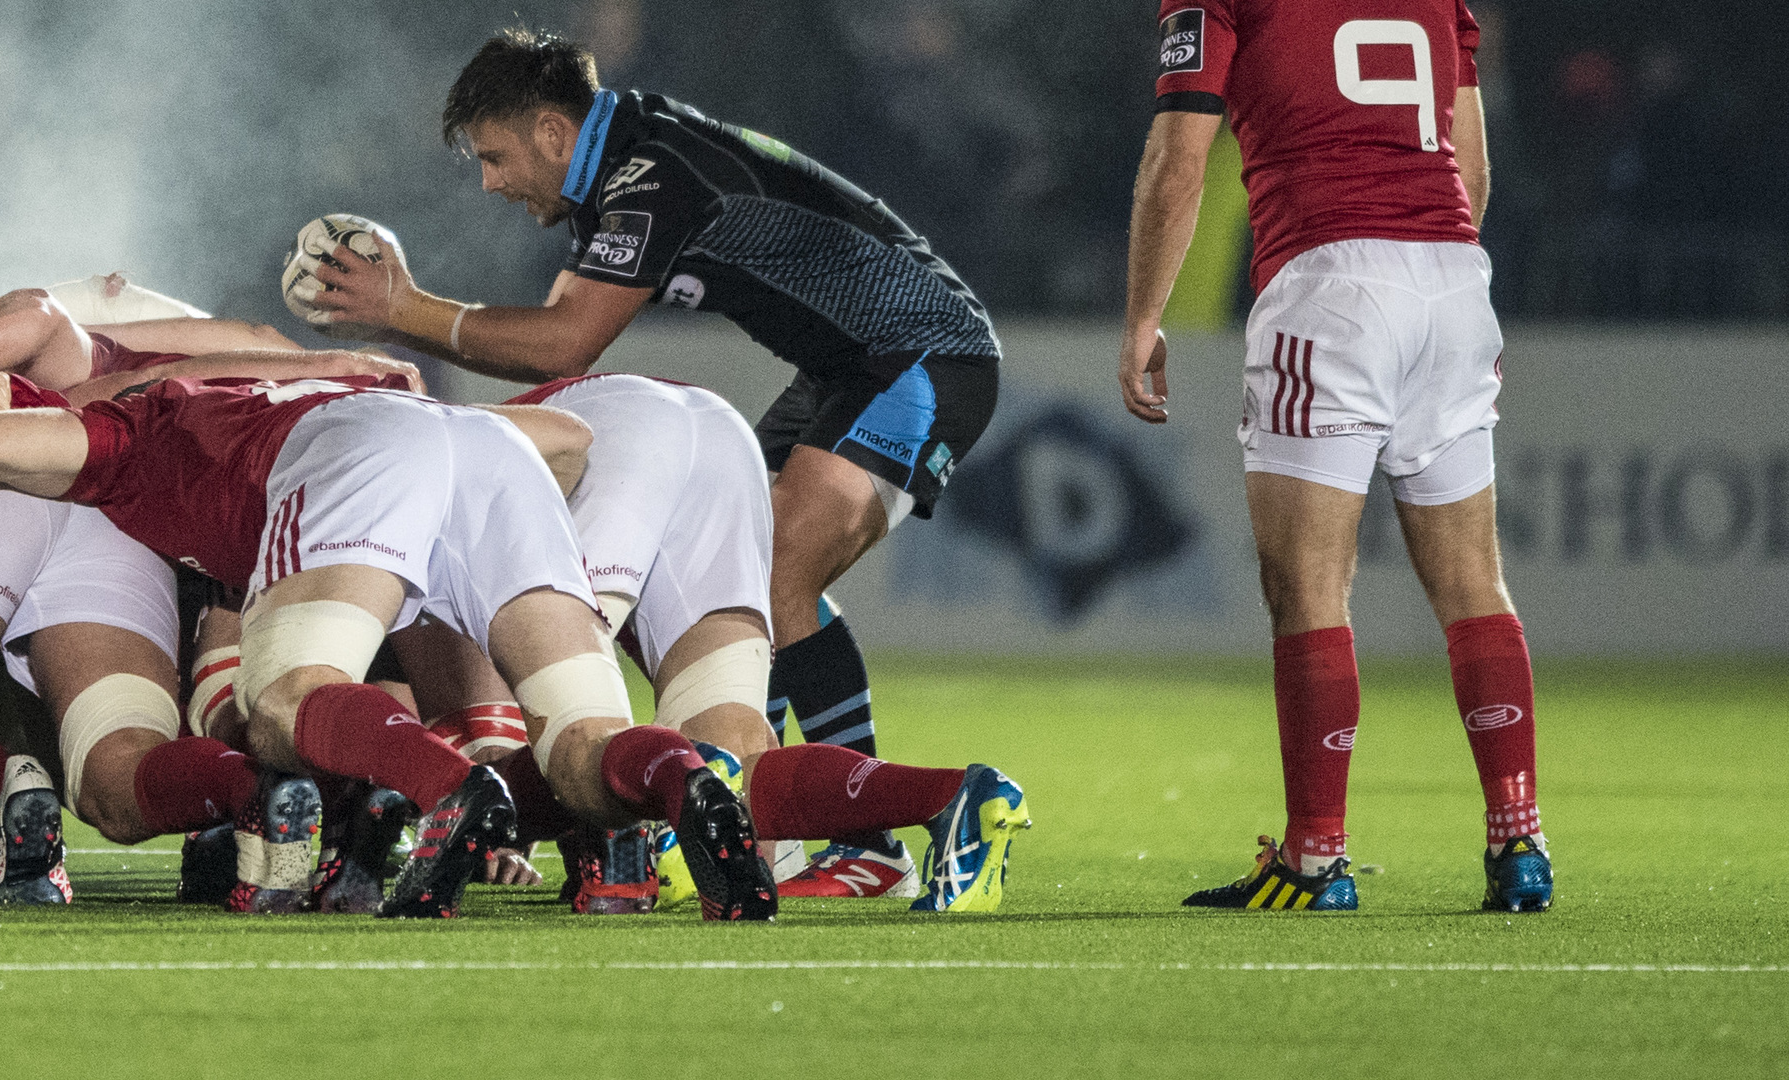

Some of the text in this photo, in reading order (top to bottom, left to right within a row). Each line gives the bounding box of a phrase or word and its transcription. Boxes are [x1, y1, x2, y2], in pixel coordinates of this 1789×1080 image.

[1333, 20, 1439, 151] 9
[625, 182, 660, 194] OILFIELD
[855, 427, 913, 461] macron
[308, 538, 406, 561] @bankofireland
